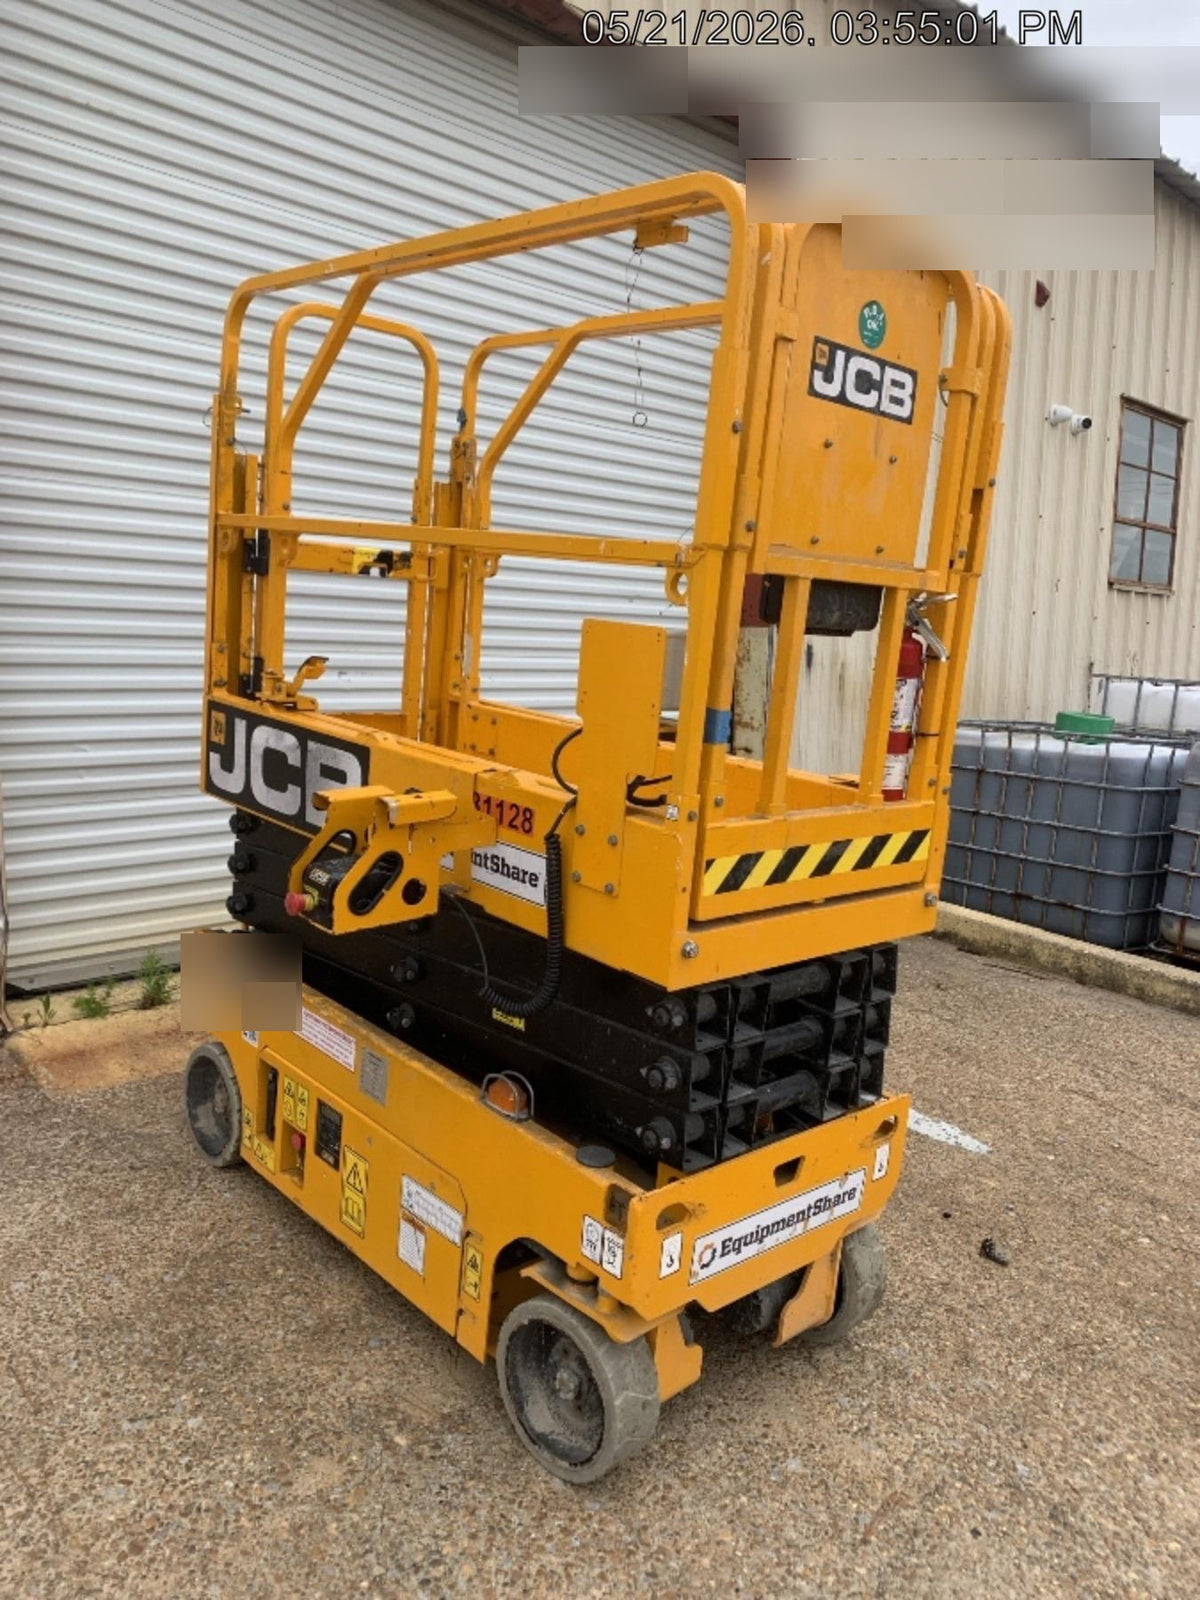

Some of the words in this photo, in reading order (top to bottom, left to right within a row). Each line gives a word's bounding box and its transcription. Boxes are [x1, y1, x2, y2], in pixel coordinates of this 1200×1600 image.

[813, 349, 914, 418] JCB
[209, 717, 362, 828] JCB
[471, 849, 539, 888] ntShare
[719, 1186, 858, 1259] EquipmentShare
